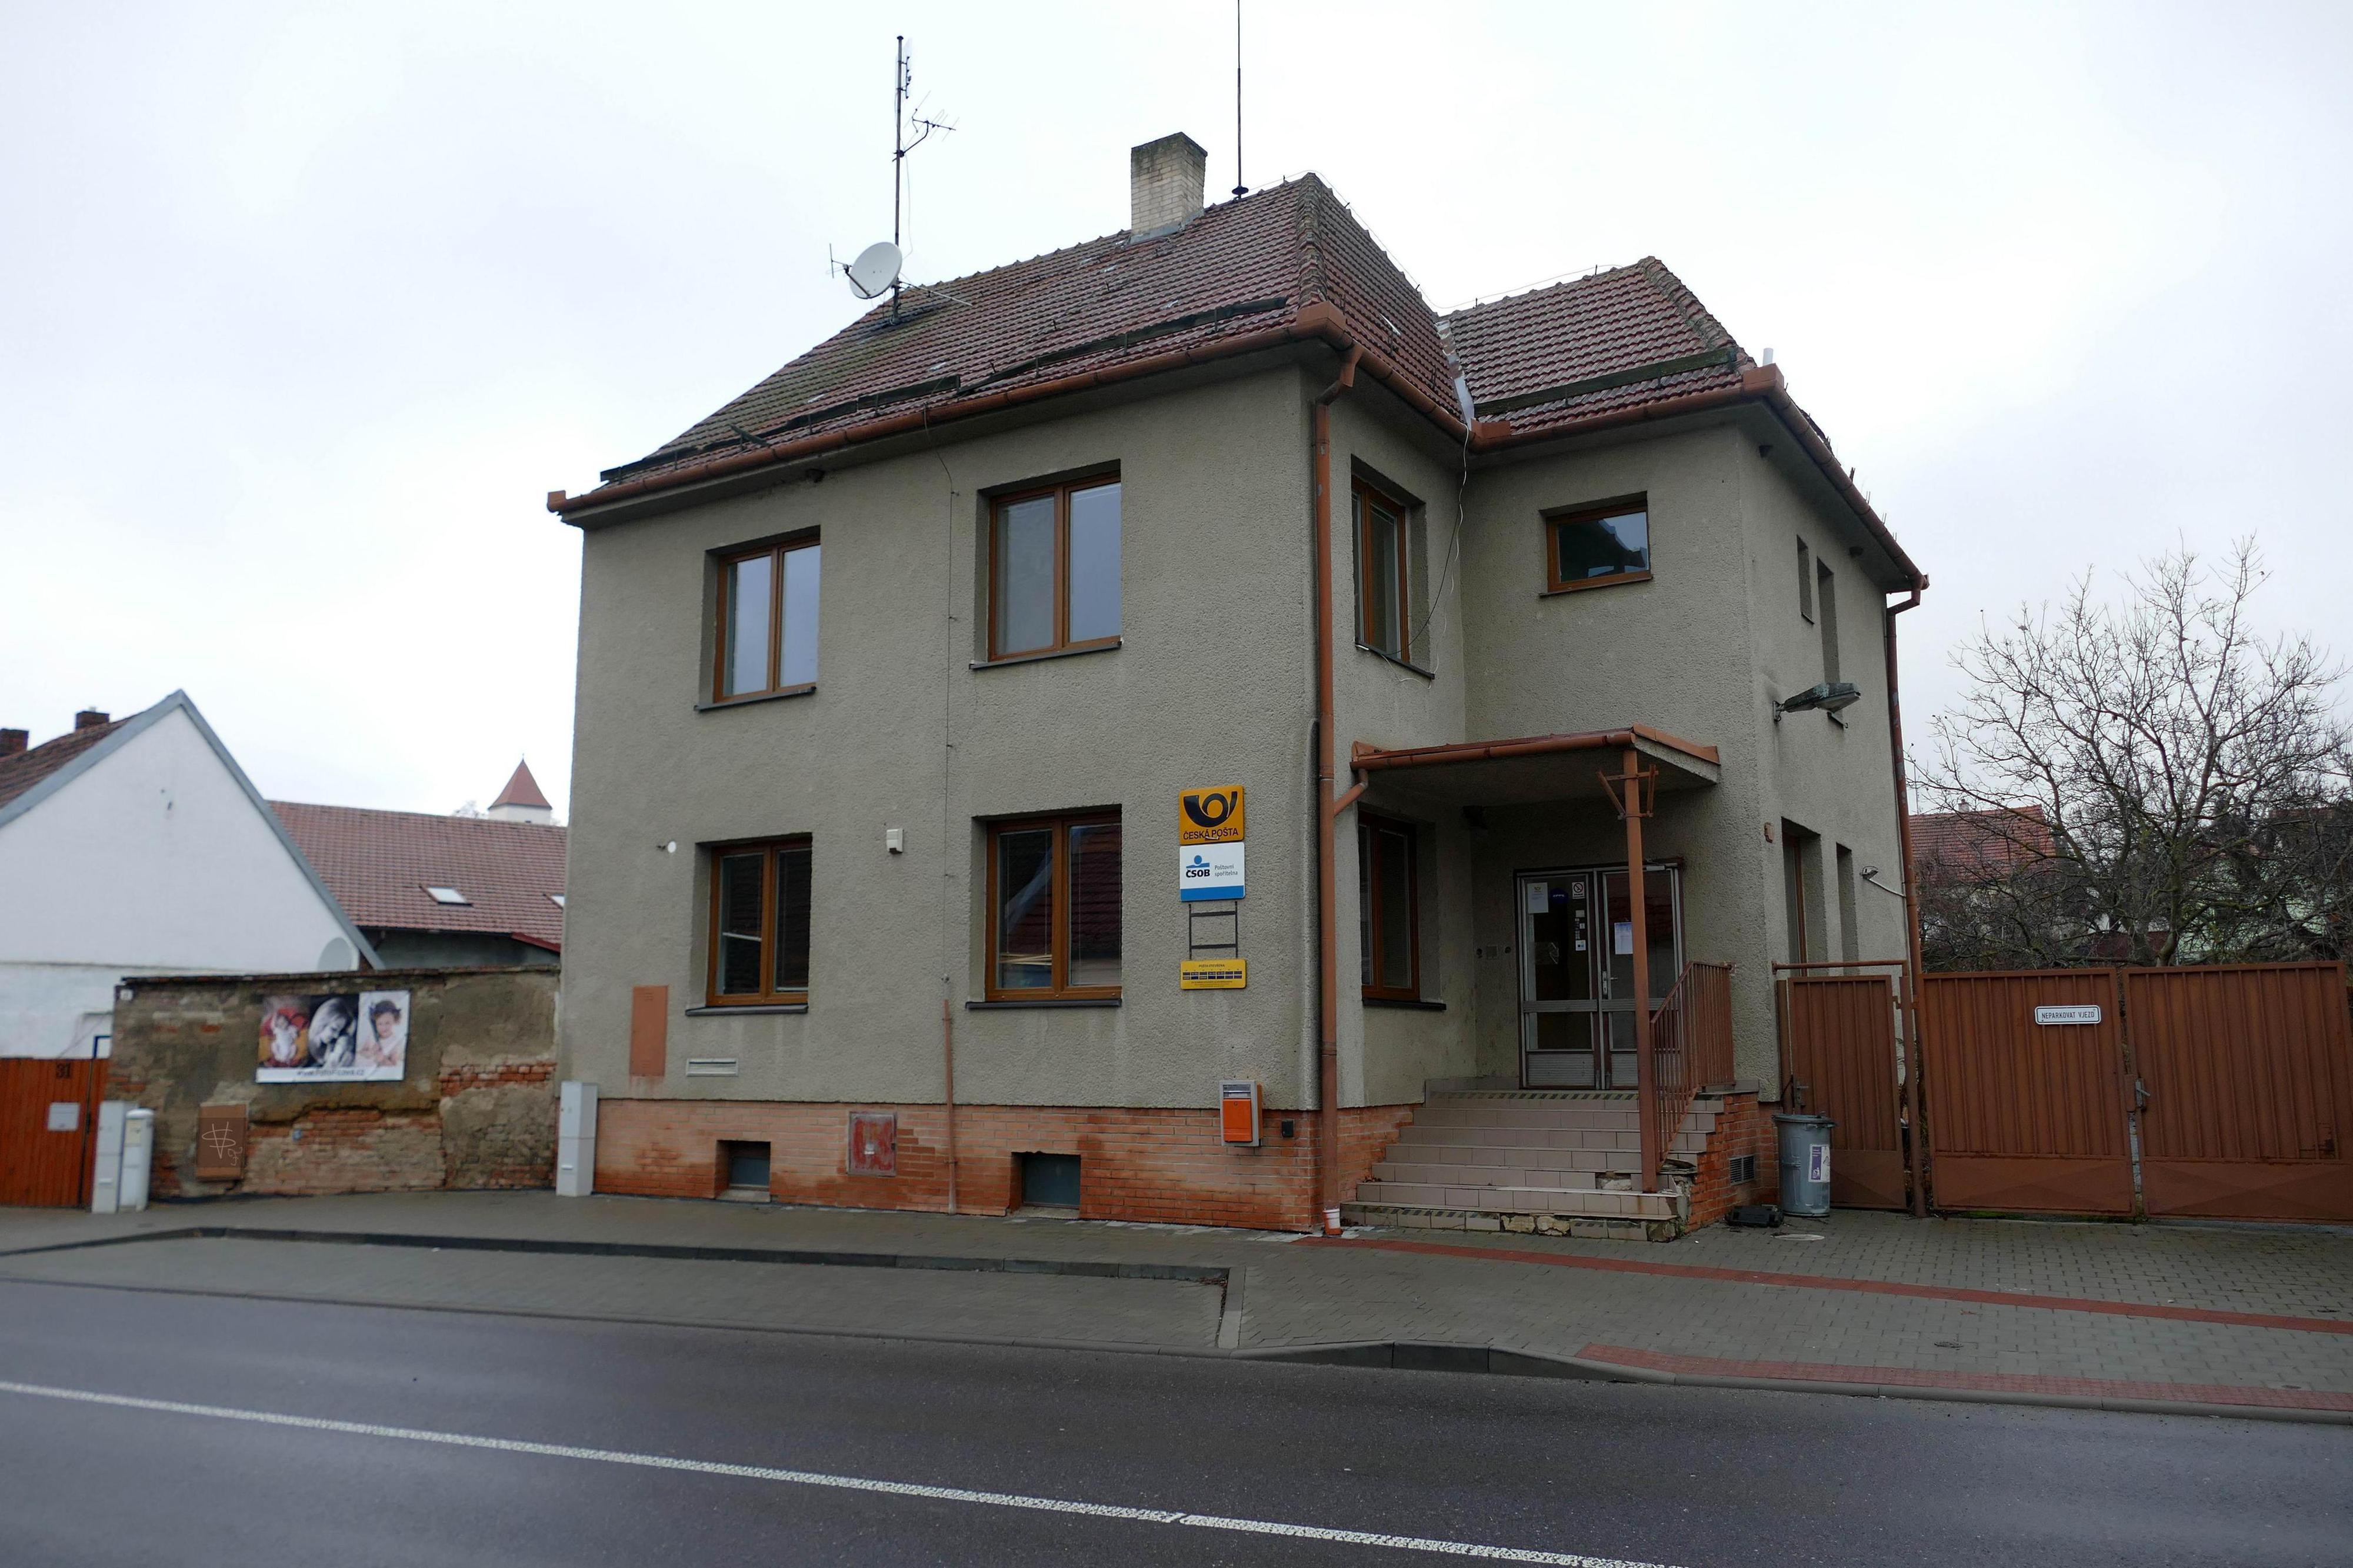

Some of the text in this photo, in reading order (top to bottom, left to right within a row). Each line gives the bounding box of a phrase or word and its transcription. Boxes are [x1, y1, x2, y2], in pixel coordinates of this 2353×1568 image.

[1183, 827, 1238, 840] ČESKÁ POŠTA
[1185, 869, 1211, 878] ČSOB
[56, 1063, 71, 1079] 31
